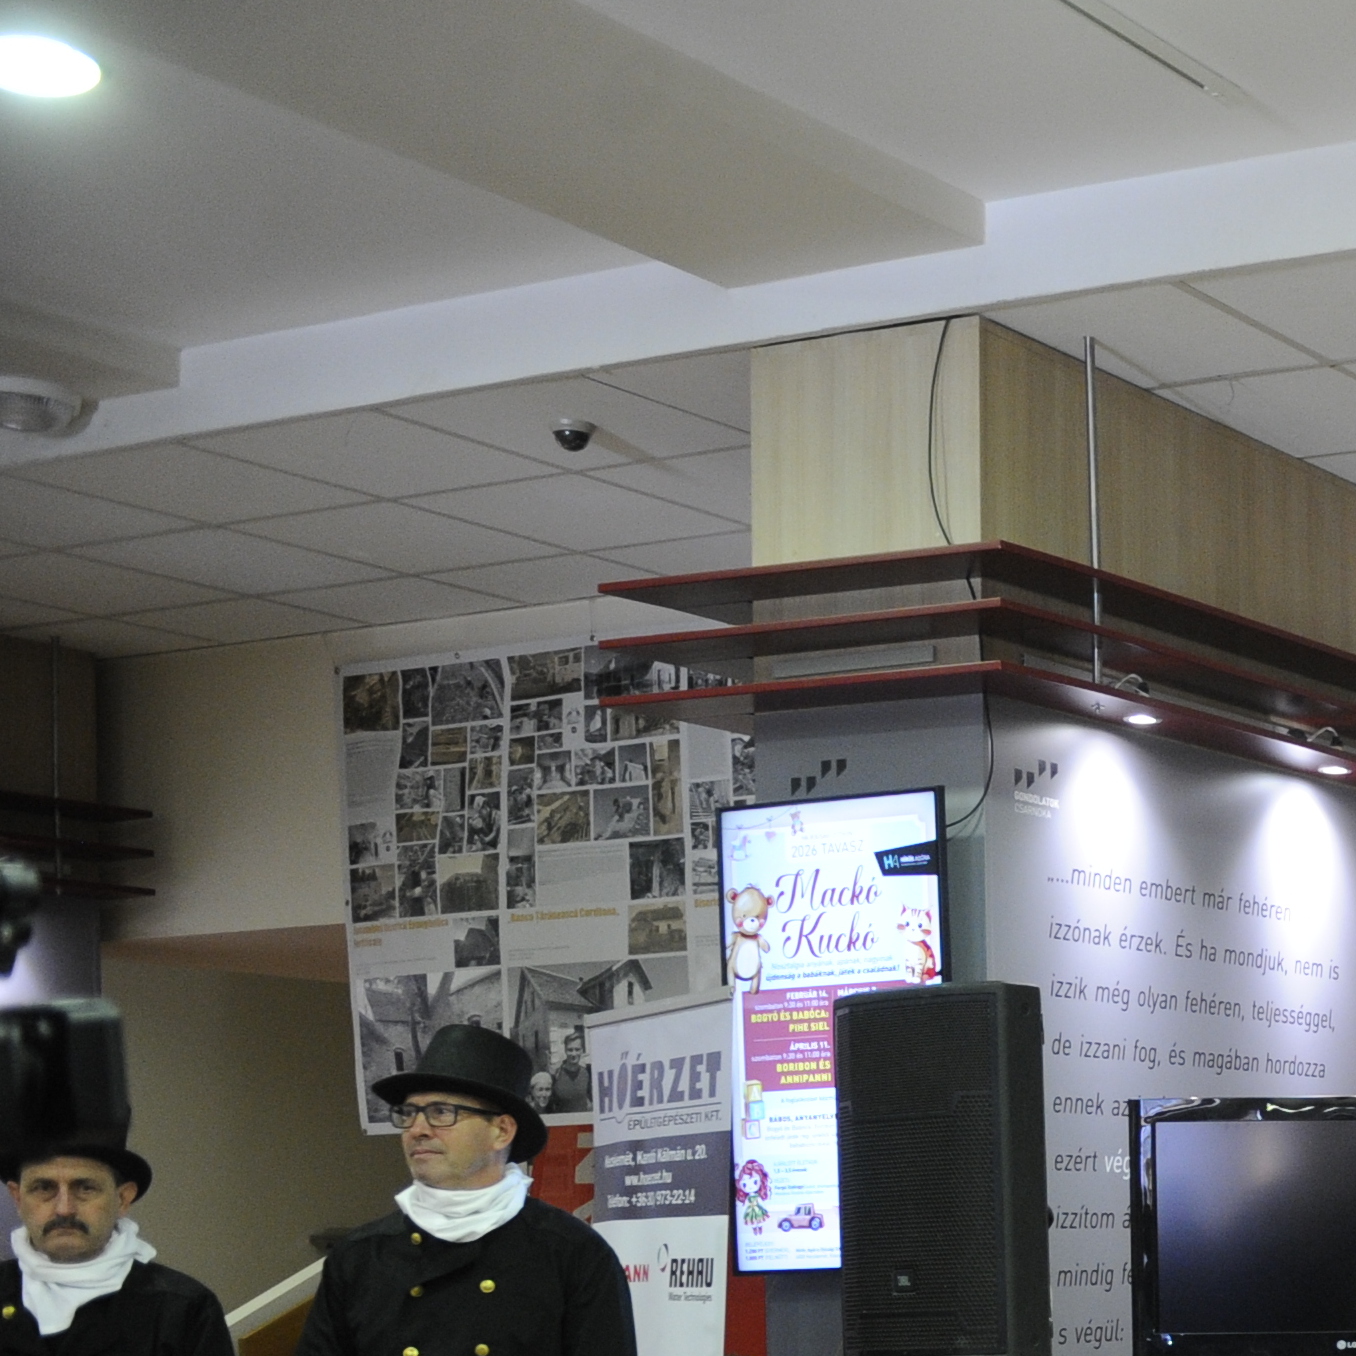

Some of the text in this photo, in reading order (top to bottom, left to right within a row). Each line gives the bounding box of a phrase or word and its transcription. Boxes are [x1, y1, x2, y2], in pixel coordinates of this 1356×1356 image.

[791, 840, 864, 859] 2026 TAVASZ
[775, 865, 882, 914] Mackó
[1139, 879, 1197, 906] embert
[1202, 888, 1232, 912] már
[1238, 892, 1292, 922] fehéren
[781, 911, 879, 959] Kuckó
[1048, 915, 1340, 981] izzónak érzek. És ha mondjuk, nem is
[1050, 973, 1336, 1034] izzik még olyan fehéren, teljességgel,
[776, 1061, 818, 1073] BORIBON
[1051, 1032, 1326, 1079] de izzani fog, és magában hordozza
[598, 1050, 722, 1114] HŐÉRZET
[780, 1072, 832, 1085] ANNIPANNI
[1052, 1092, 1105, 1117] ennek
[1054, 1149, 1098, 1173] ezért
[1055, 1205, 1115, 1230] izzítom
[669, 1257, 714, 1288] REHAU
[1057, 1263, 1114, 1292] mindig
[1058, 1320, 1124, 1350] s végül:
